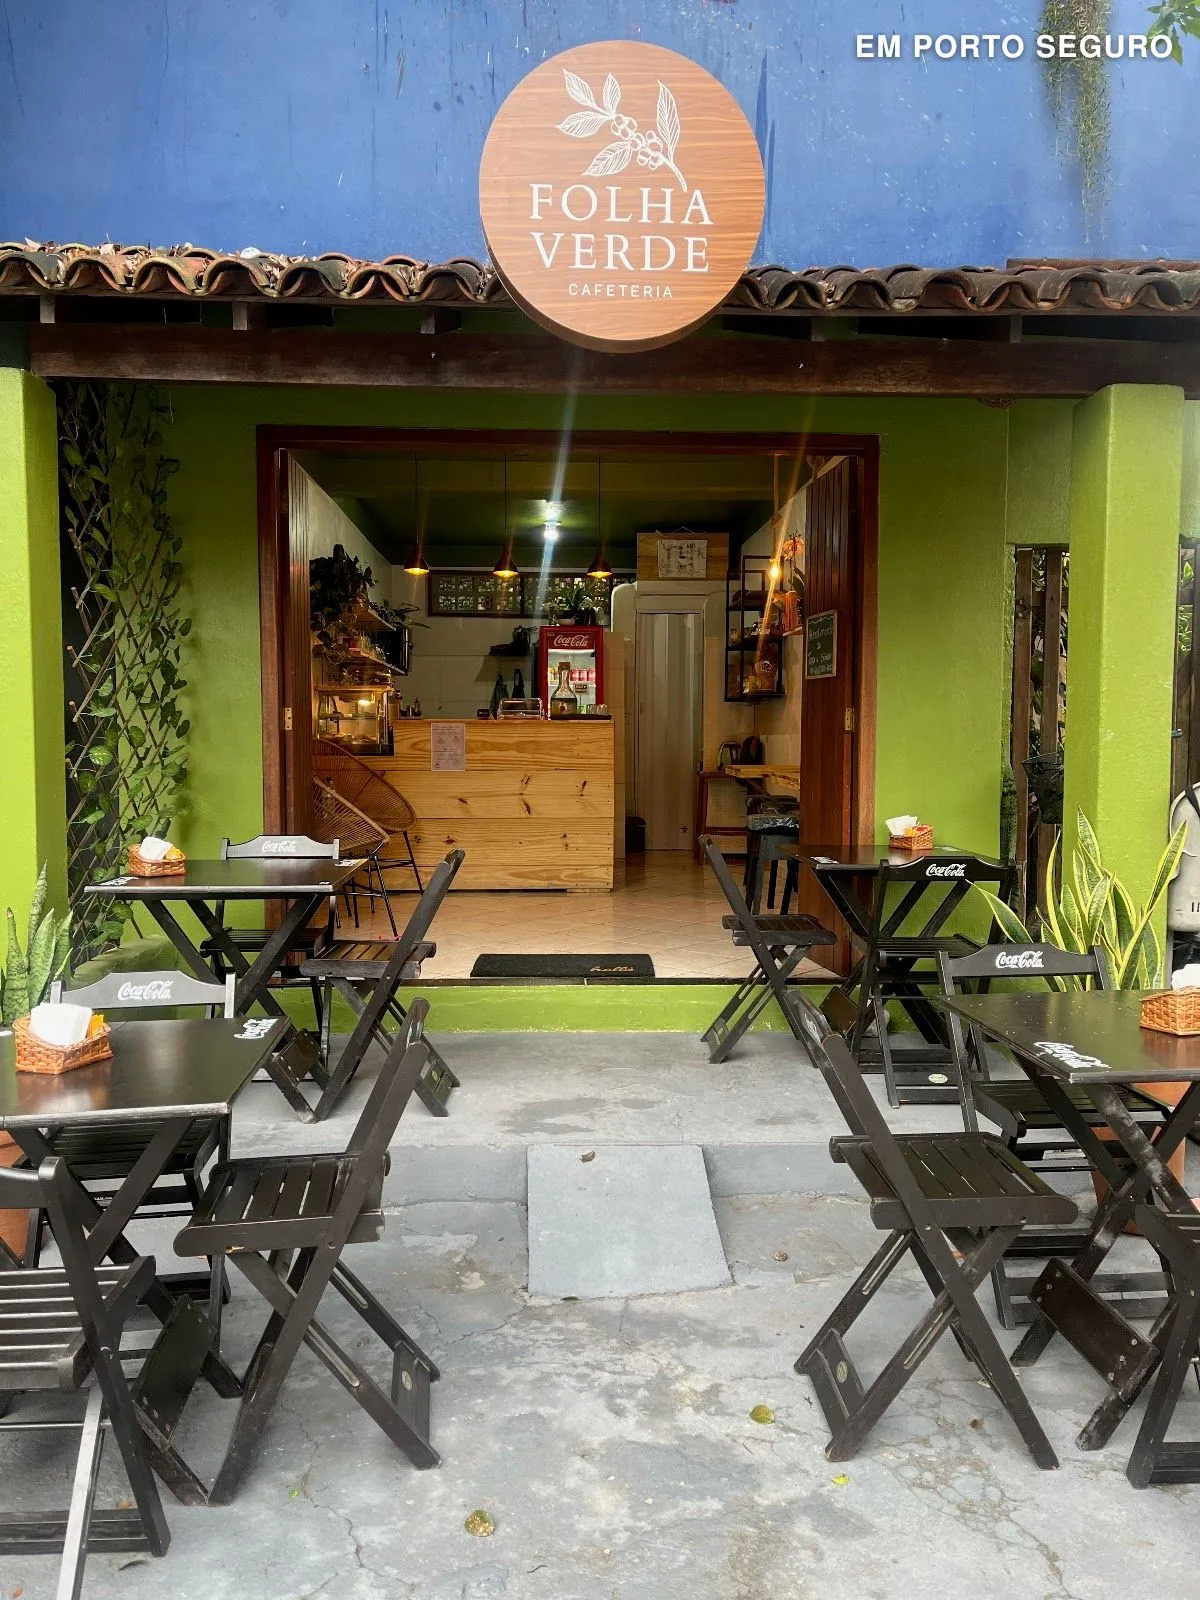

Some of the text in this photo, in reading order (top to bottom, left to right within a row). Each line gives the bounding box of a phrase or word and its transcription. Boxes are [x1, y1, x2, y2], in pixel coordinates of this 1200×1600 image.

[529, 183, 714, 225] FOLHA
[530, 231, 709, 273] VERDE
[568, 283, 673, 298] CAFETERIA
